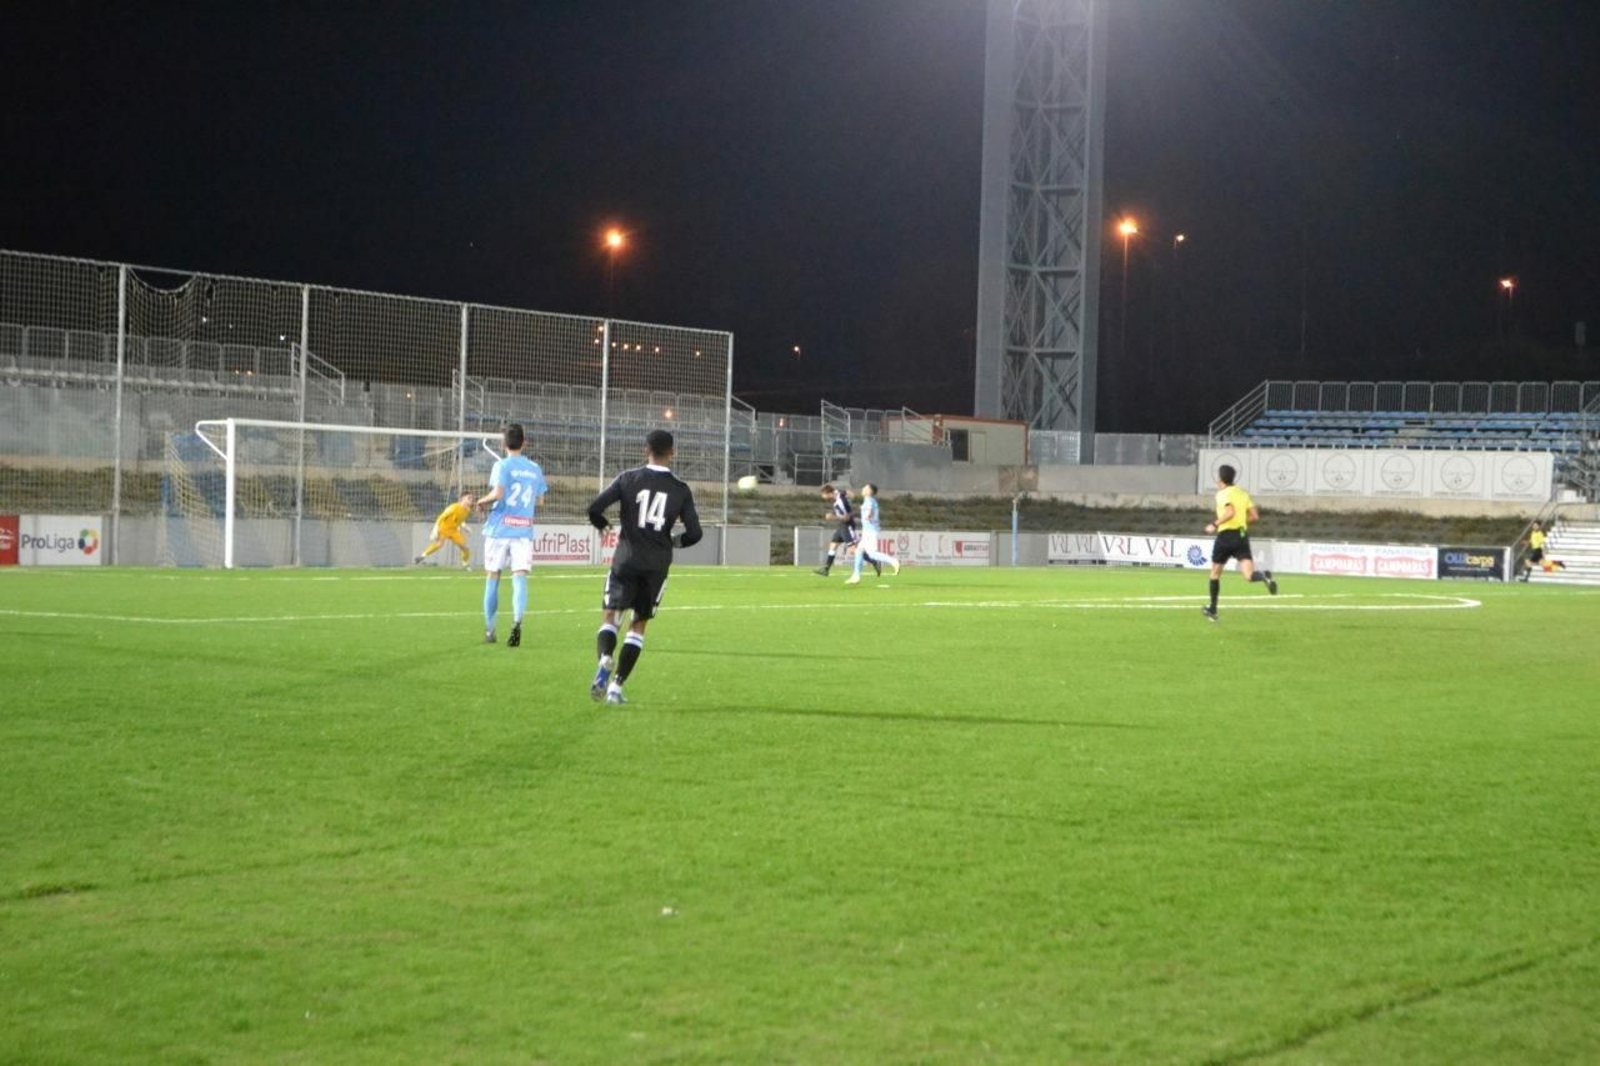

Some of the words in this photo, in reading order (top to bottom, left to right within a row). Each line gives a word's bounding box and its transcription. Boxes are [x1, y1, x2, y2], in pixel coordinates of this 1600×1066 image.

[505, 482, 533, 508] 24
[636, 489, 668, 531] 14
[21, 533, 75, 554] ProLiga
[530, 532, 590, 553] ufriPlast
[1103, 535, 1139, 556] VRL
[1145, 537, 1181, 558] VRL
